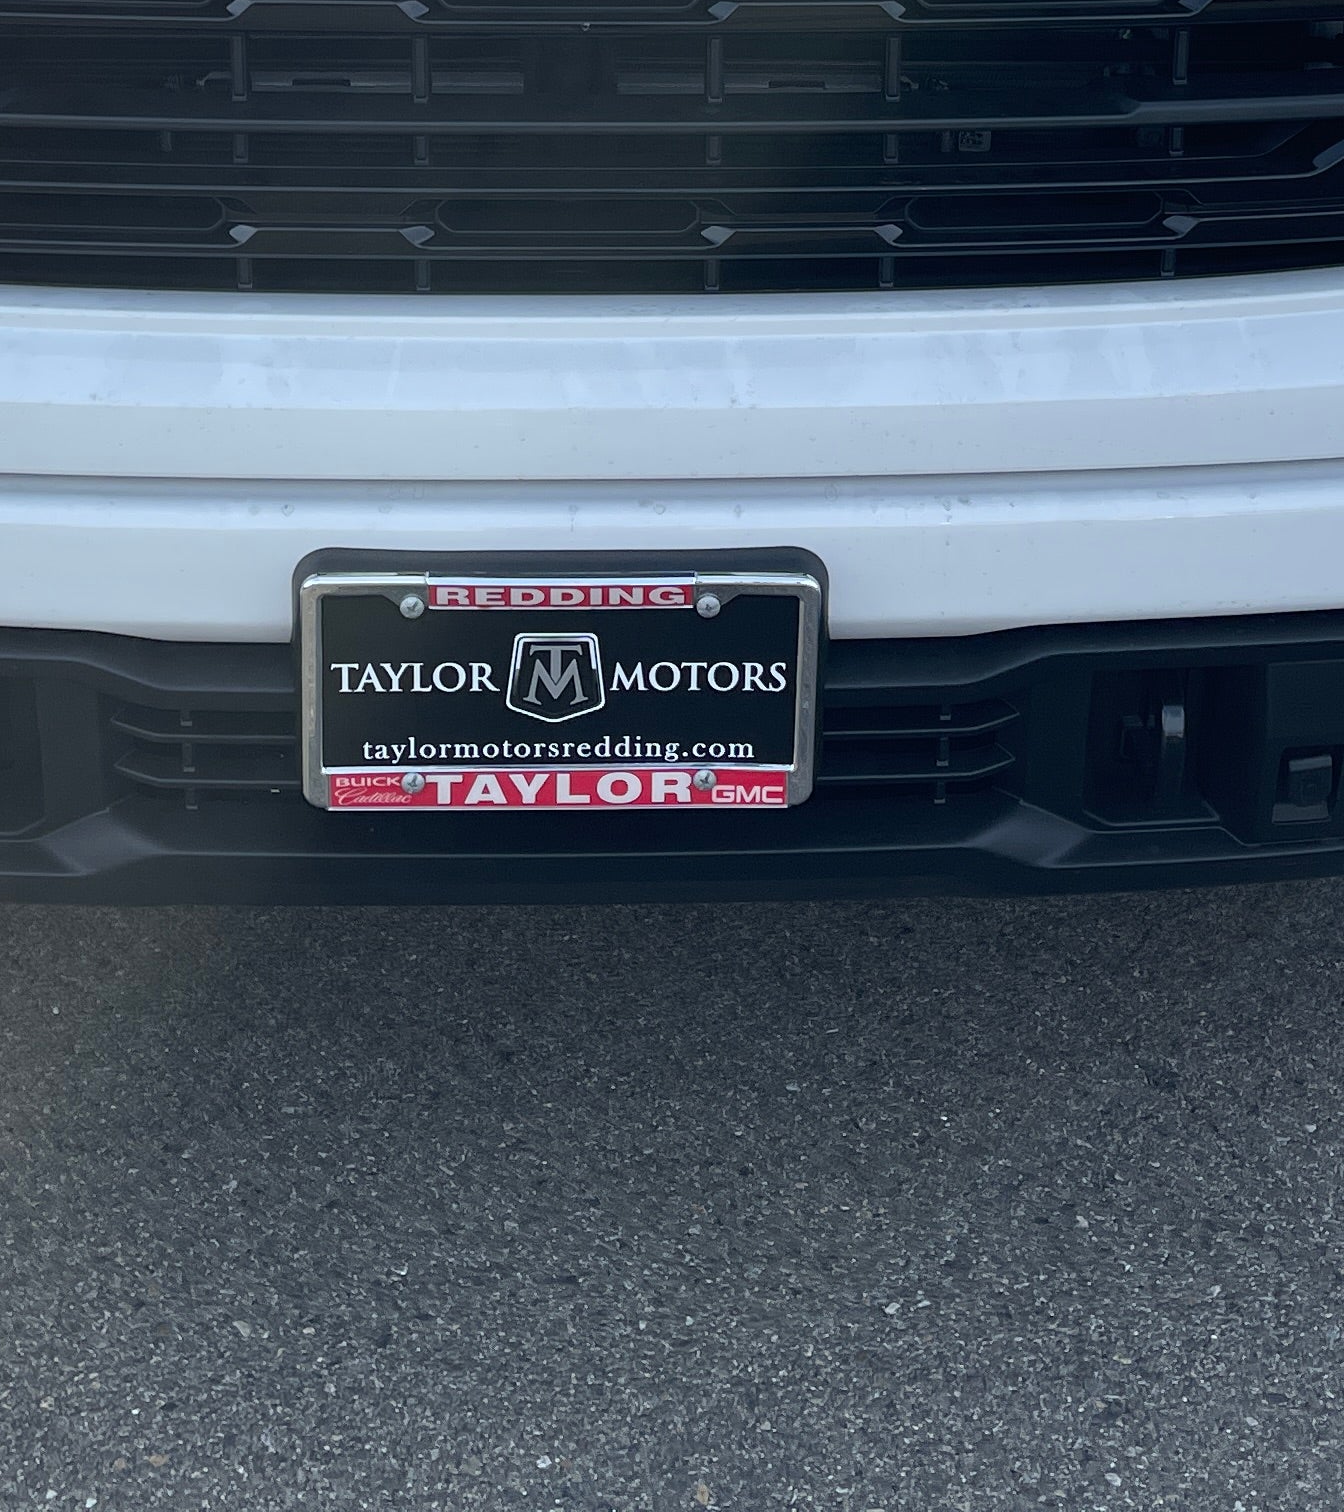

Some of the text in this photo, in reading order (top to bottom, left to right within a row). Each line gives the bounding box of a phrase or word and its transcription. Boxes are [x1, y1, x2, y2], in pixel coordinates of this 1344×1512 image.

[436, 587, 685, 607] REDDING
[331, 662, 500, 693] TAYLOR
[611, 661, 787, 692] MOTORS
[363, 736, 755, 763] taylormotorsredding.com
[335, 775, 401, 788] BUICK
[425, 771, 692, 805] TAYLOR
[334, 787, 413, 806] Cadillac
[712, 784, 784, 804] GMC
